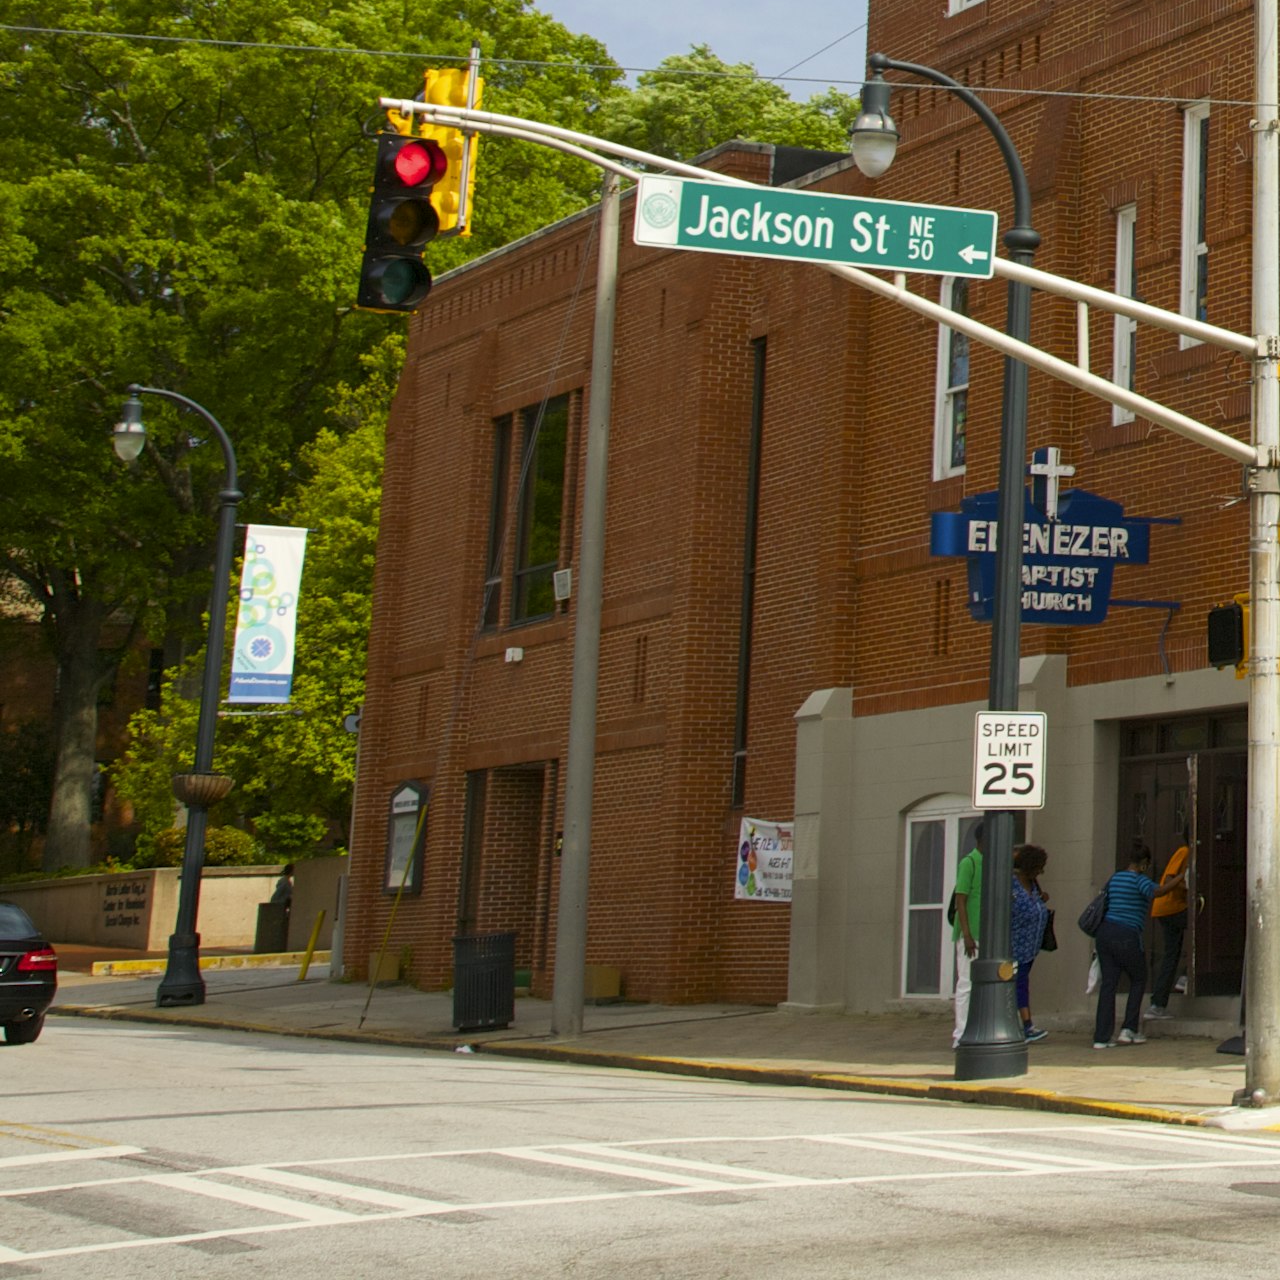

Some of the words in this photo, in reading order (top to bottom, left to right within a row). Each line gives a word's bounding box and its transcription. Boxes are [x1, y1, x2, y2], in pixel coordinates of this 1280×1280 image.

[685, 194, 834, 249] Jackson
[850, 211, 892, 255] St
[908, 215, 936, 239] NE
[907, 238, 935, 261] 50
[1021, 564, 1099, 588] APTIST
[1021, 591, 1093, 612] HURCH
[982, 723, 1040, 737] SPEED
[988, 743, 1032, 757] LIMIT
[982, 762, 1035, 796] 25
